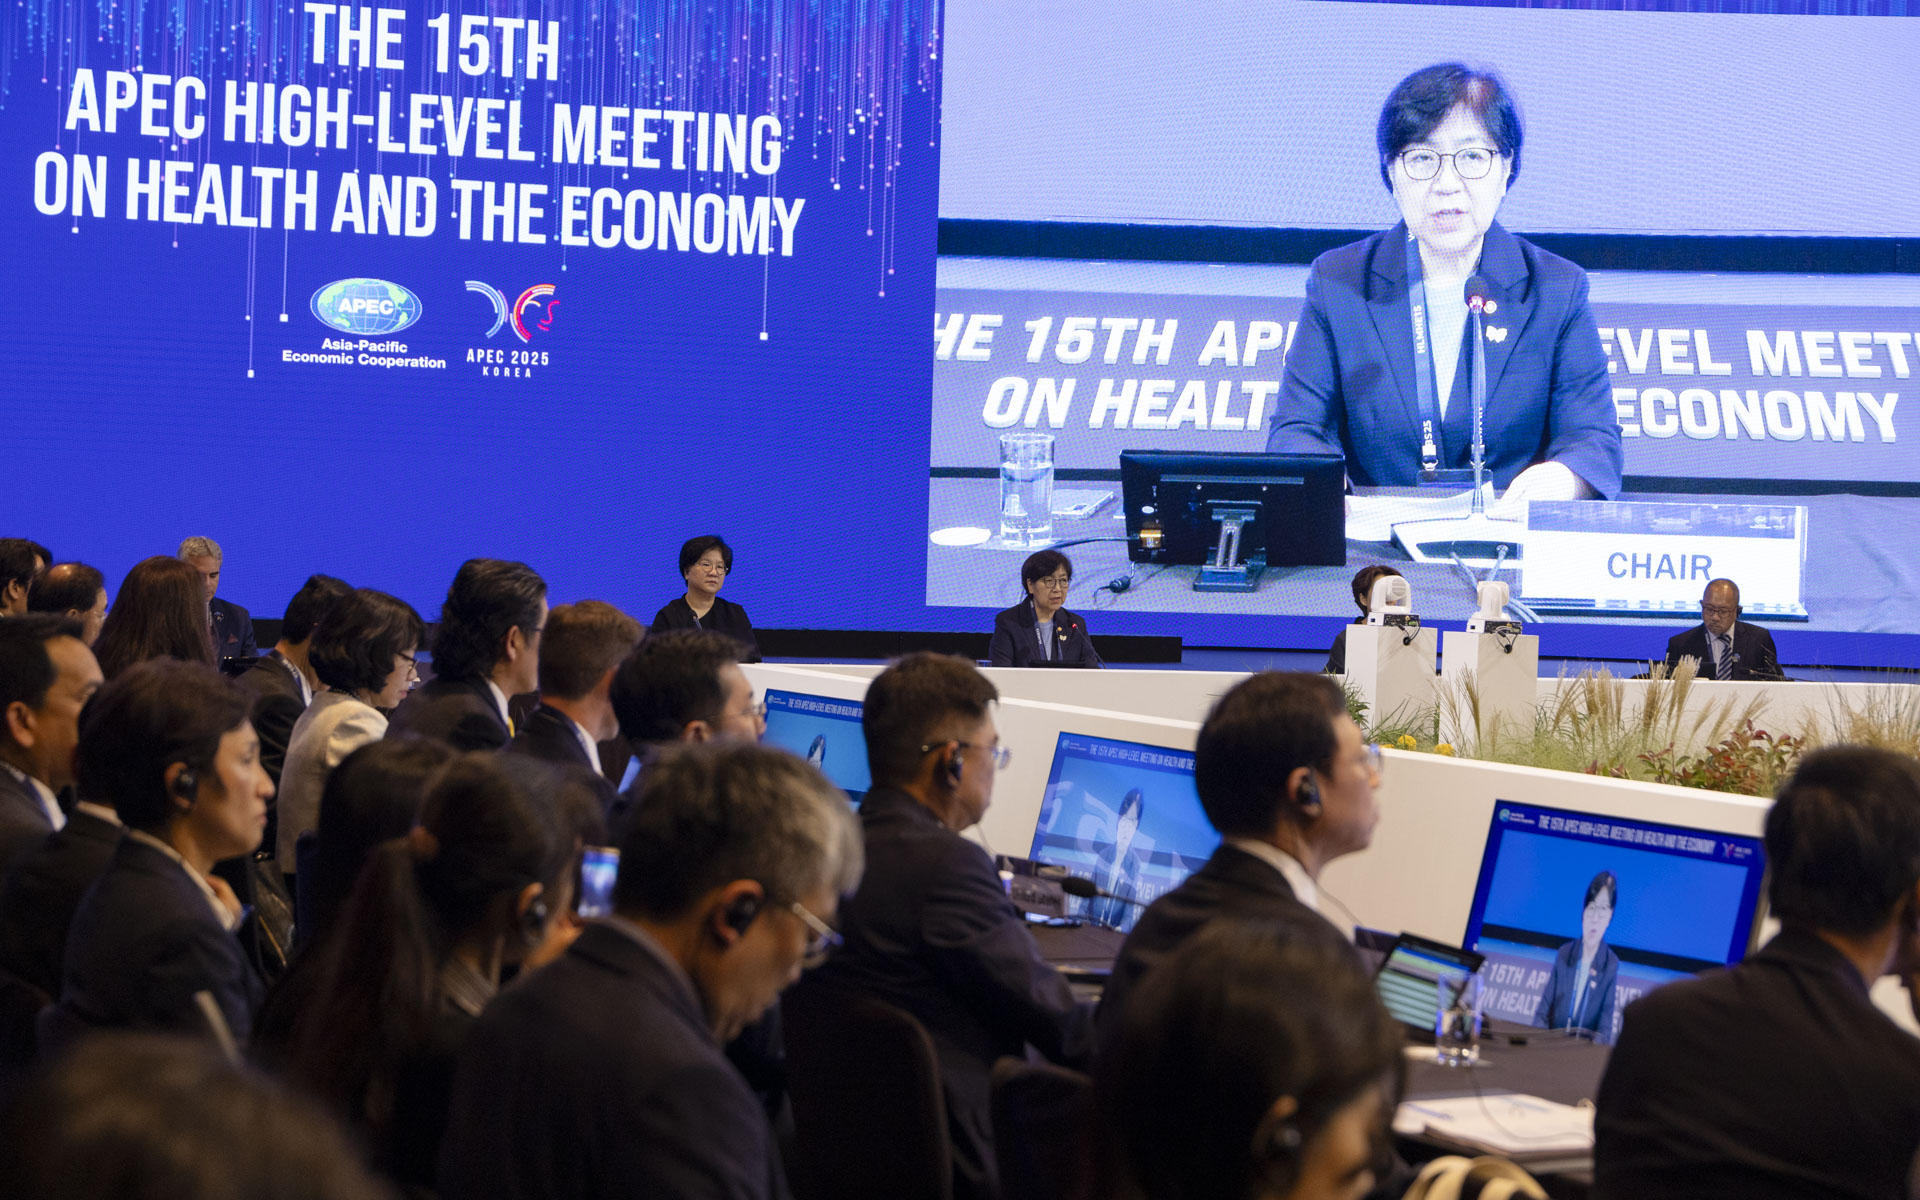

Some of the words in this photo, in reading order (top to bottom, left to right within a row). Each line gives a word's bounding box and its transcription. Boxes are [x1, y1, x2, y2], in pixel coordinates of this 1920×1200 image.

[305, 2, 406, 71] THE
[428, 13, 559, 81] 15TH
[65, 68, 206, 139] APEC
[223, 79, 535, 162] HIGH-LEVEL
[552, 103, 782, 175] MEETING
[34, 151, 107, 218] ON
[126, 157, 318, 231] HEALTH
[331, 172, 437, 238] AND
[451, 179, 548, 245] THE
[561, 185, 805, 257] ECONOMY
[338, 298, 394, 315] APEC
[282, 349, 354, 365] Economic
[358, 353, 446, 369] Cooperation
[321, 338, 408, 353] Asia-Pacific
[466, 348, 504, 364] APEC
[511, 350, 549, 366] 2025
[1024, 316, 1178, 365] 15TH
[1198, 320, 1299, 367] AP
[1746, 329, 1920, 379] MEET
[482, 366, 531, 378] KOREA
[982, 376, 1076, 429] ON
[1612, 387, 1899, 443] ECONOMY
[1607, 551, 1713, 581] CHAIR
